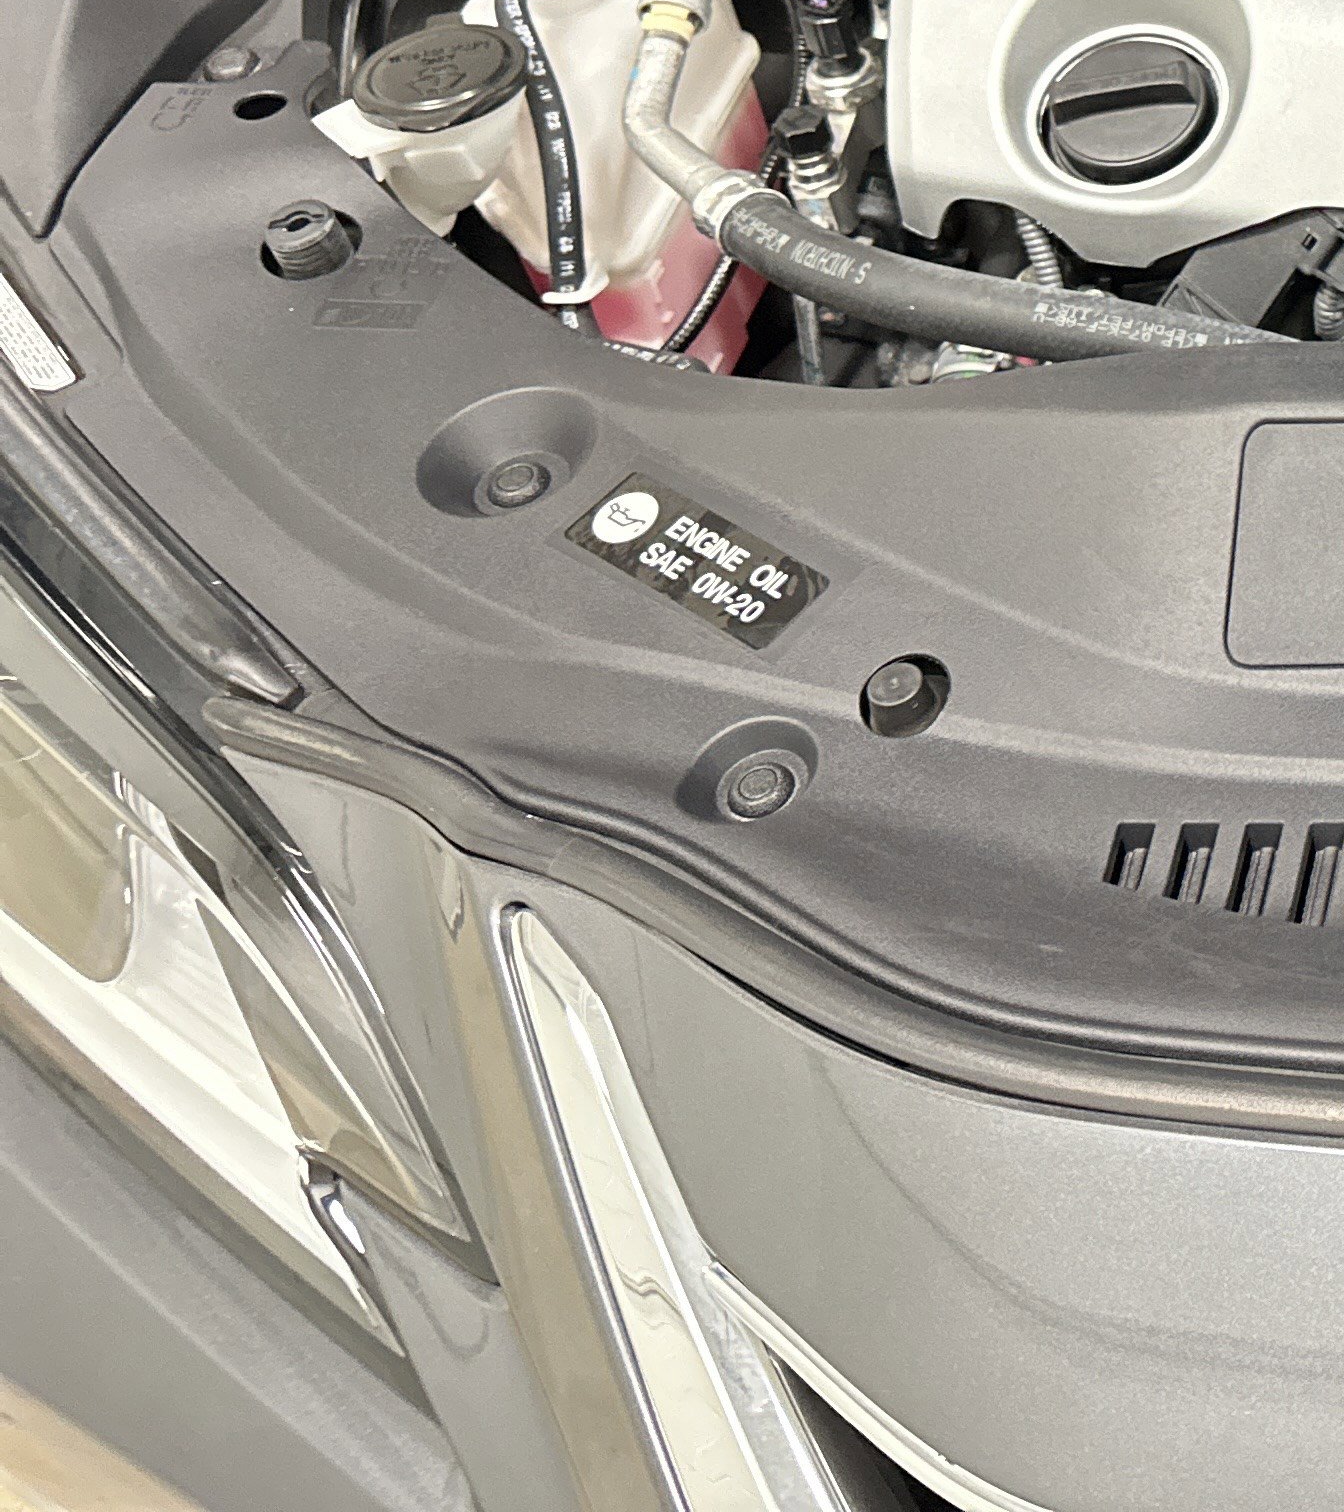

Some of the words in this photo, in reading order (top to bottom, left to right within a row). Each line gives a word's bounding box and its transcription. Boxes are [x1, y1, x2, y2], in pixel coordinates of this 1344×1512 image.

[639, 542, 693, 580] SAE
[692, 573, 765, 623] 0W-20
[665, 515, 751, 571] ENGINE
[750, 564, 789, 599] OIL
